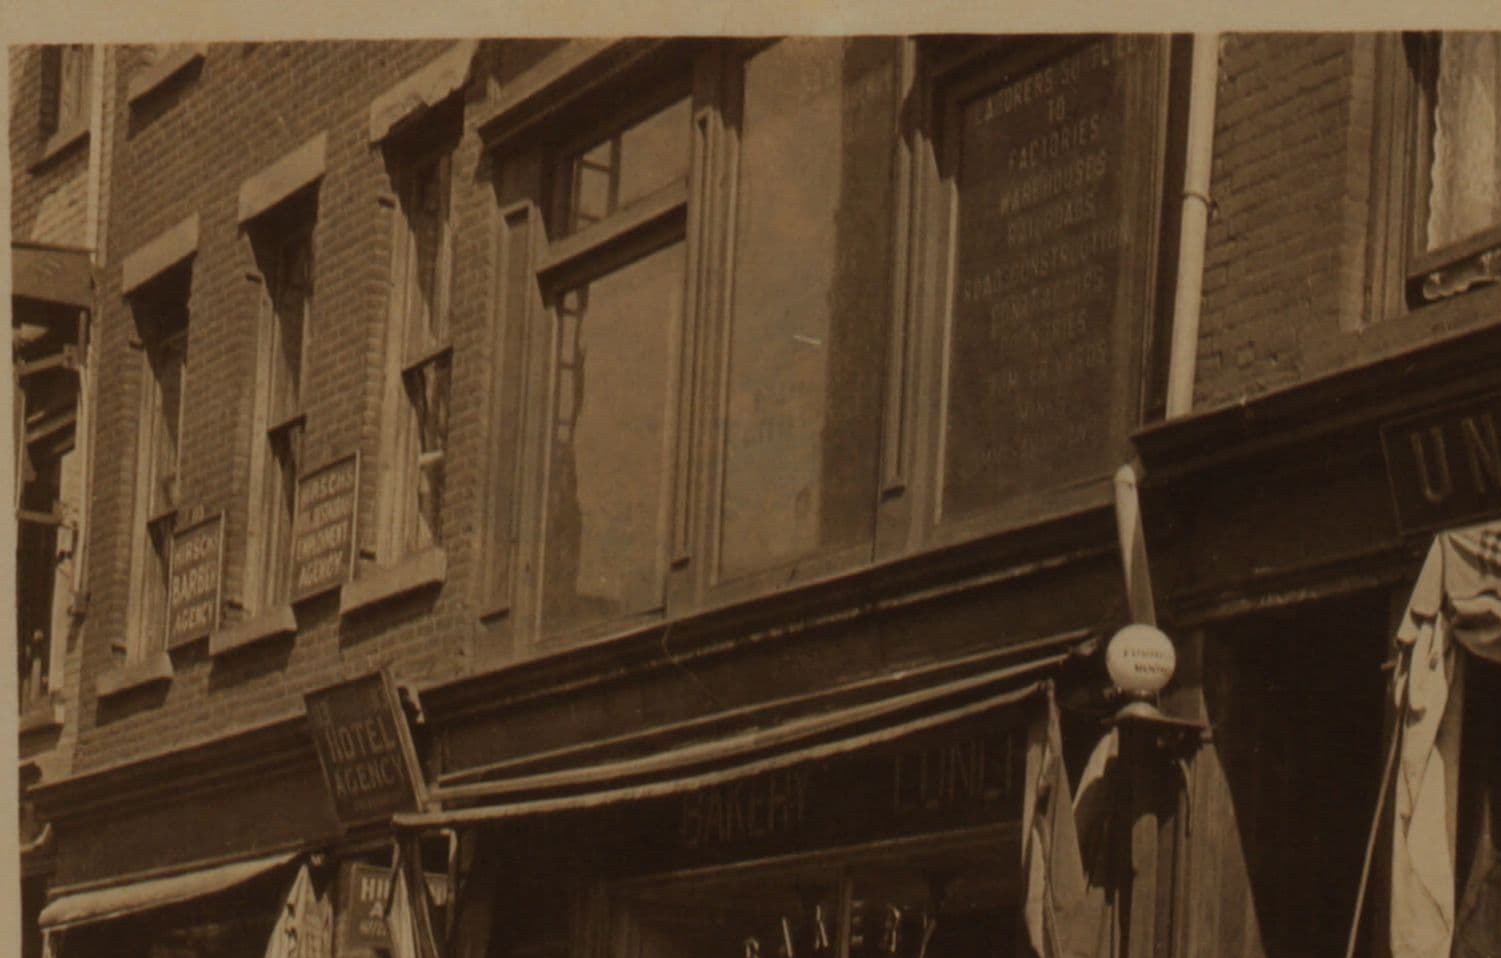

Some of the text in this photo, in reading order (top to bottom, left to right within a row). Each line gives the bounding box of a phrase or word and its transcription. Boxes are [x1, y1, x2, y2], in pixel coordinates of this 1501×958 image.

[1049, 94, 1066, 125] TO
[325, 715, 397, 763] HOTEL
[334, 753, 405, 799] AGENCY
